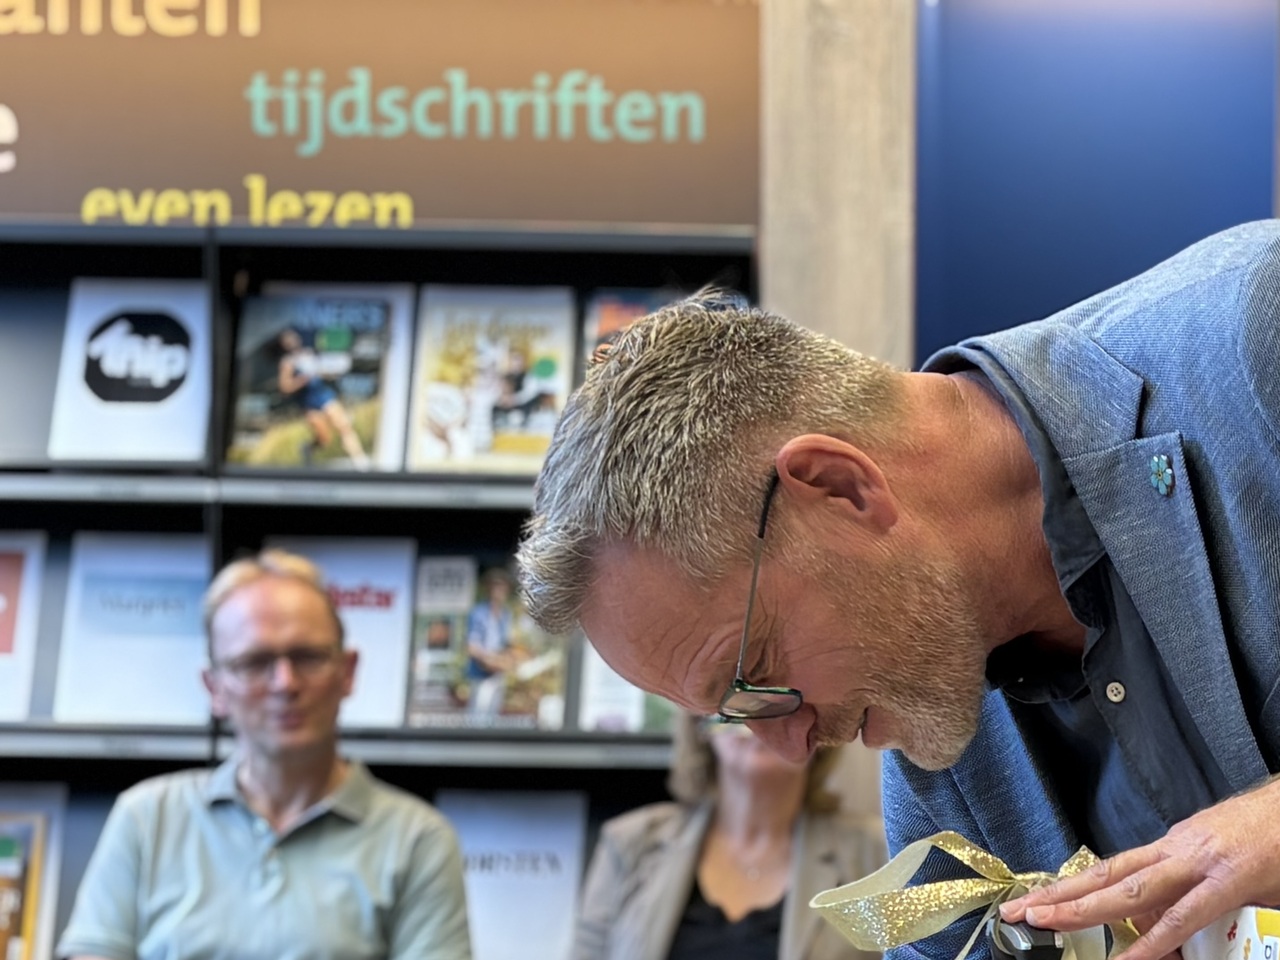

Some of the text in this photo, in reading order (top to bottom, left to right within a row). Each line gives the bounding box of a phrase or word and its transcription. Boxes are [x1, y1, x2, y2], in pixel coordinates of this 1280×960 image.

[244, 66, 706, 157] tijdschriften
[80, 174, 413, 229] even lezen
